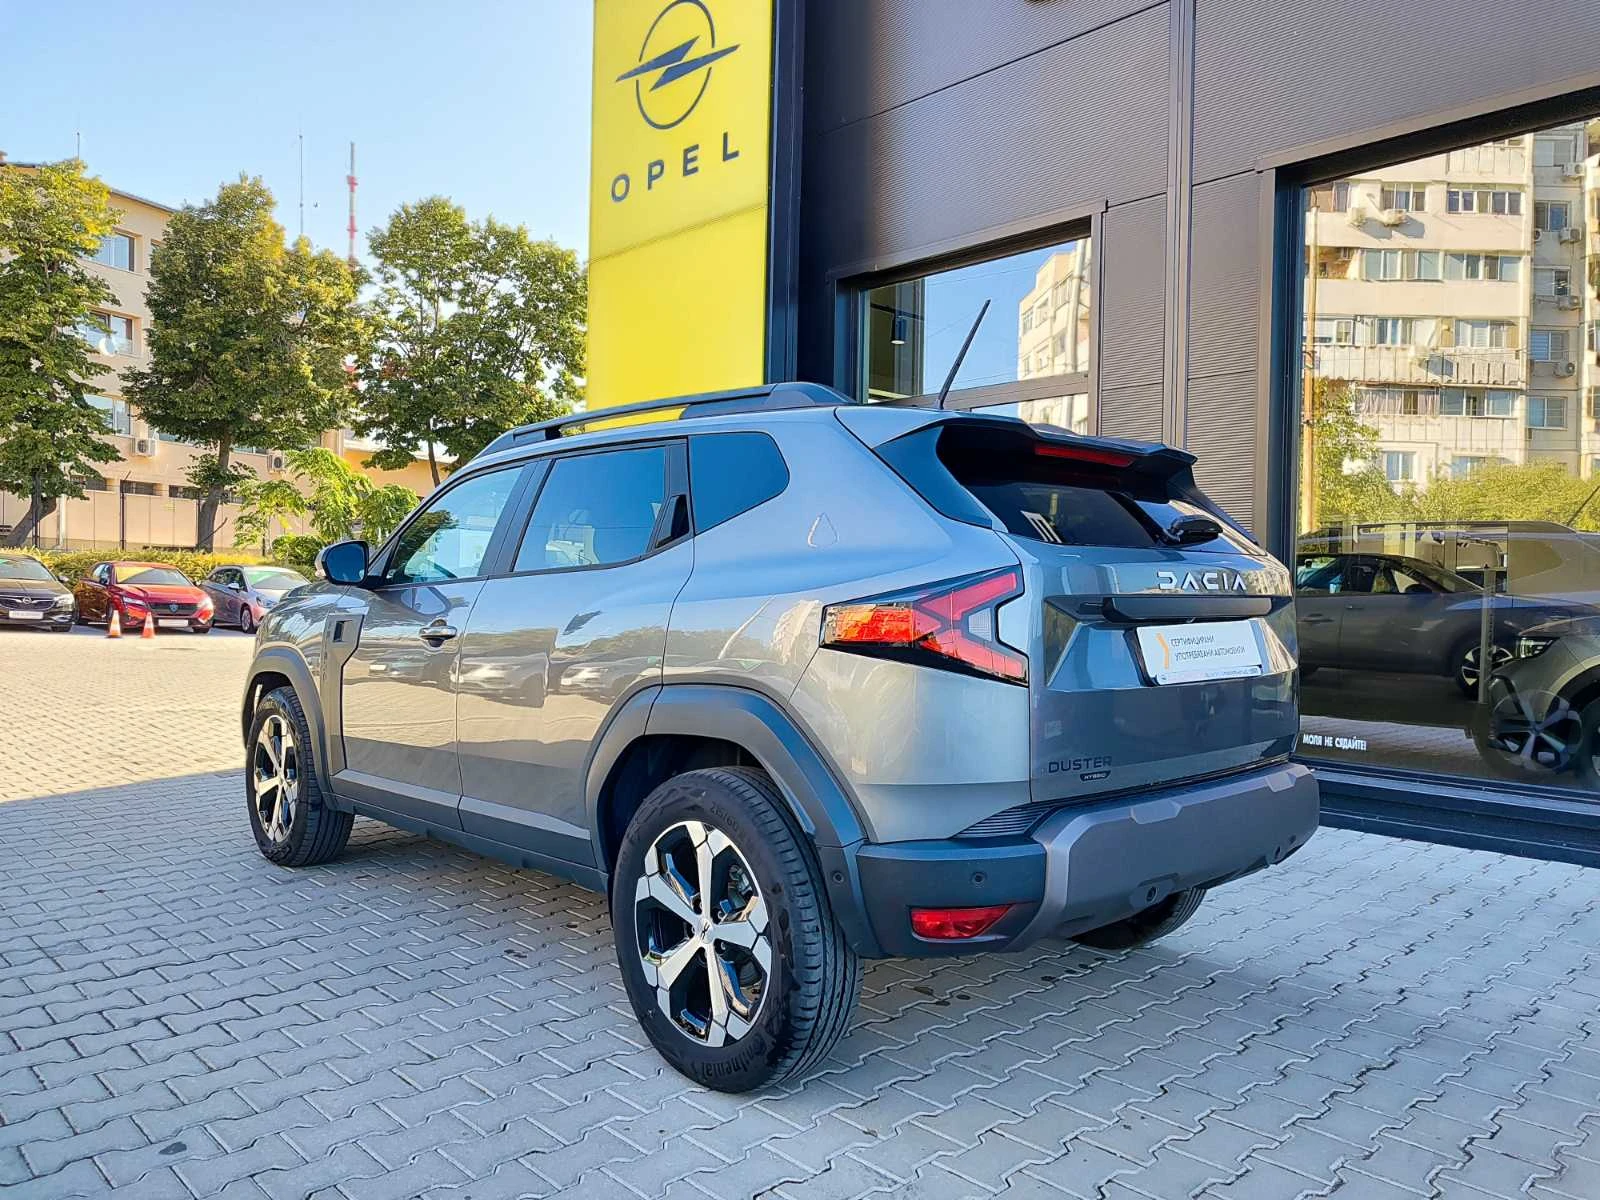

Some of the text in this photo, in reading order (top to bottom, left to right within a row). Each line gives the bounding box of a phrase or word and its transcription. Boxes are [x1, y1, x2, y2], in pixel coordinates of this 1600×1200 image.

[611, 132, 739, 202] OPEL
[1157, 572, 1247, 592] DACIA
[1324, 736, 1334, 747] НЕ
[1048, 755, 1113, 774] DUSTER
